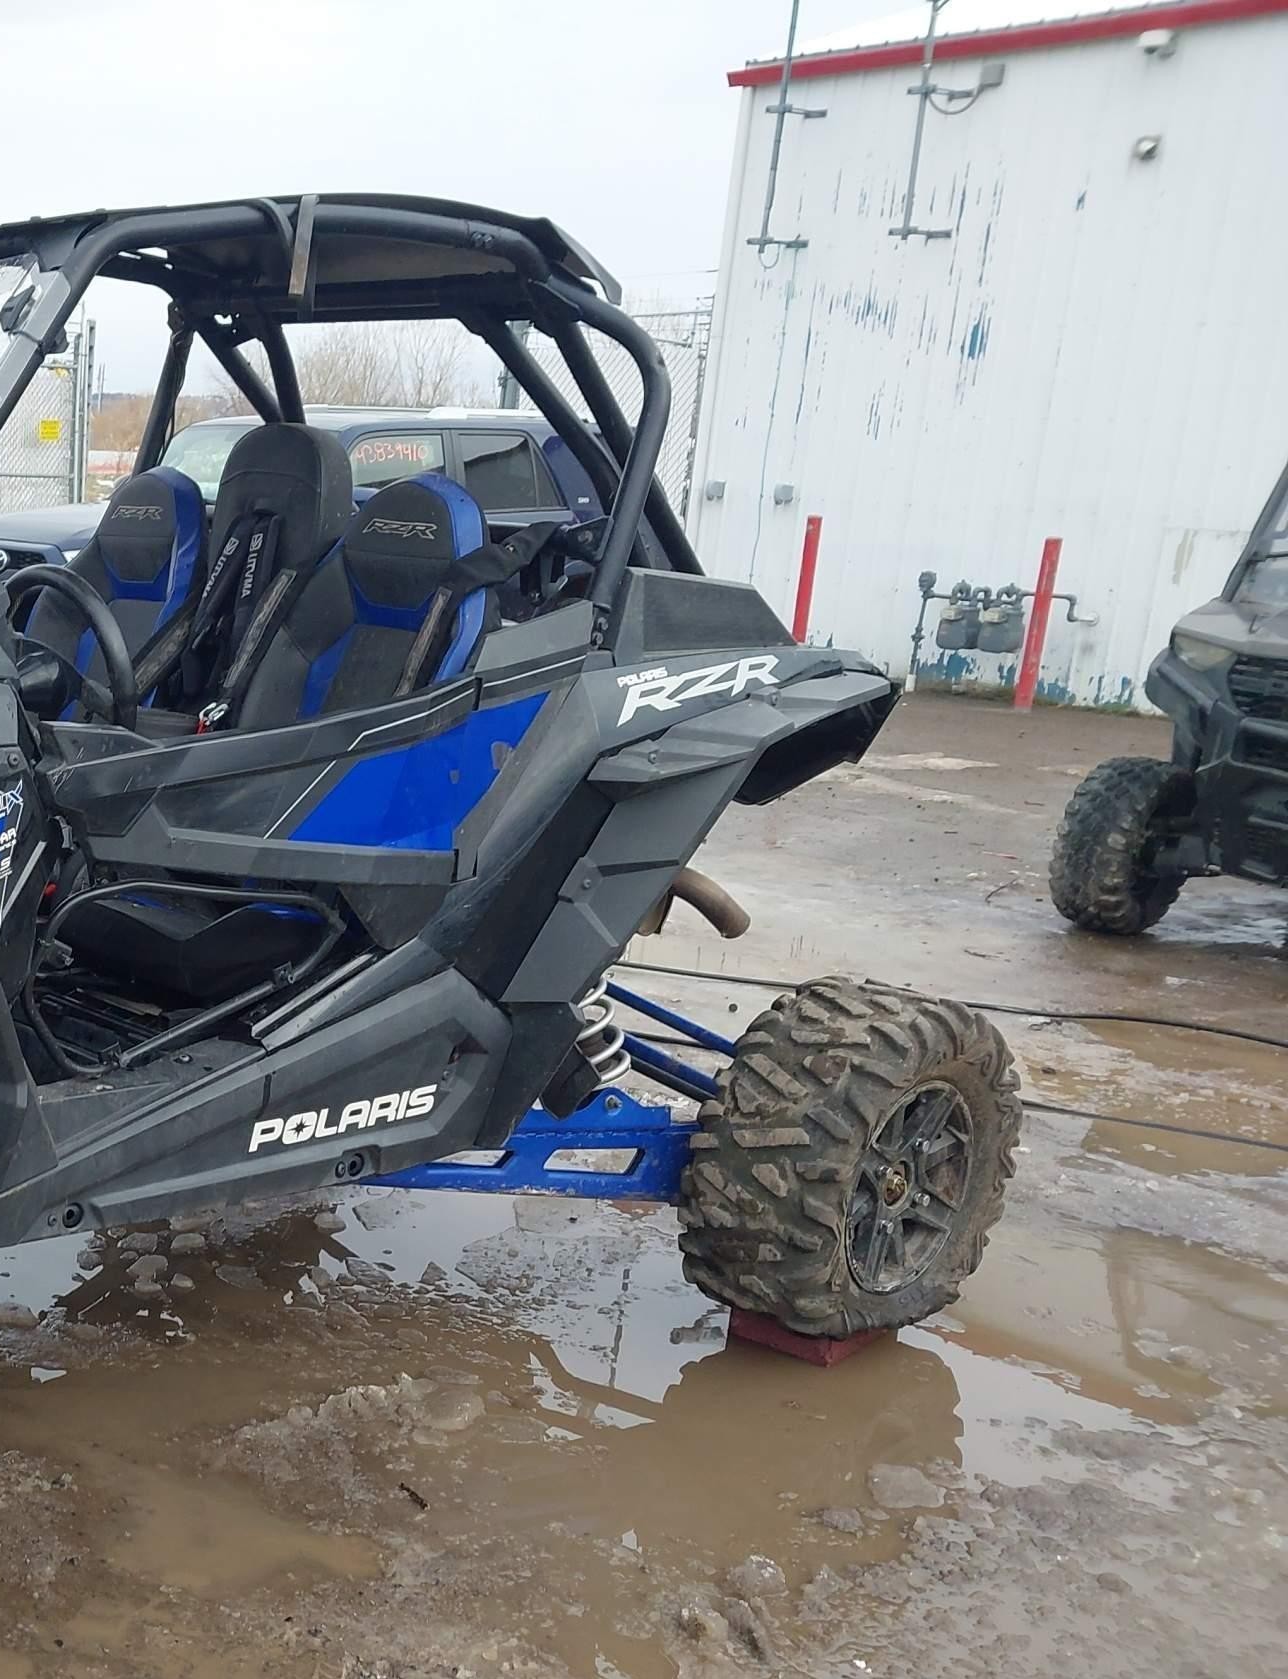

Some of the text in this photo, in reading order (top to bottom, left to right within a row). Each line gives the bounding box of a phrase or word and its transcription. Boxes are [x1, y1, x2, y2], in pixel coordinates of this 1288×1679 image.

[111, 505, 163, 520] RZR
[362, 518, 437, 540] RZR
[616, 666, 668, 688] POLARIS
[616, 654, 781, 728] RZR
[248, 1084, 438, 1153] POLARIS
